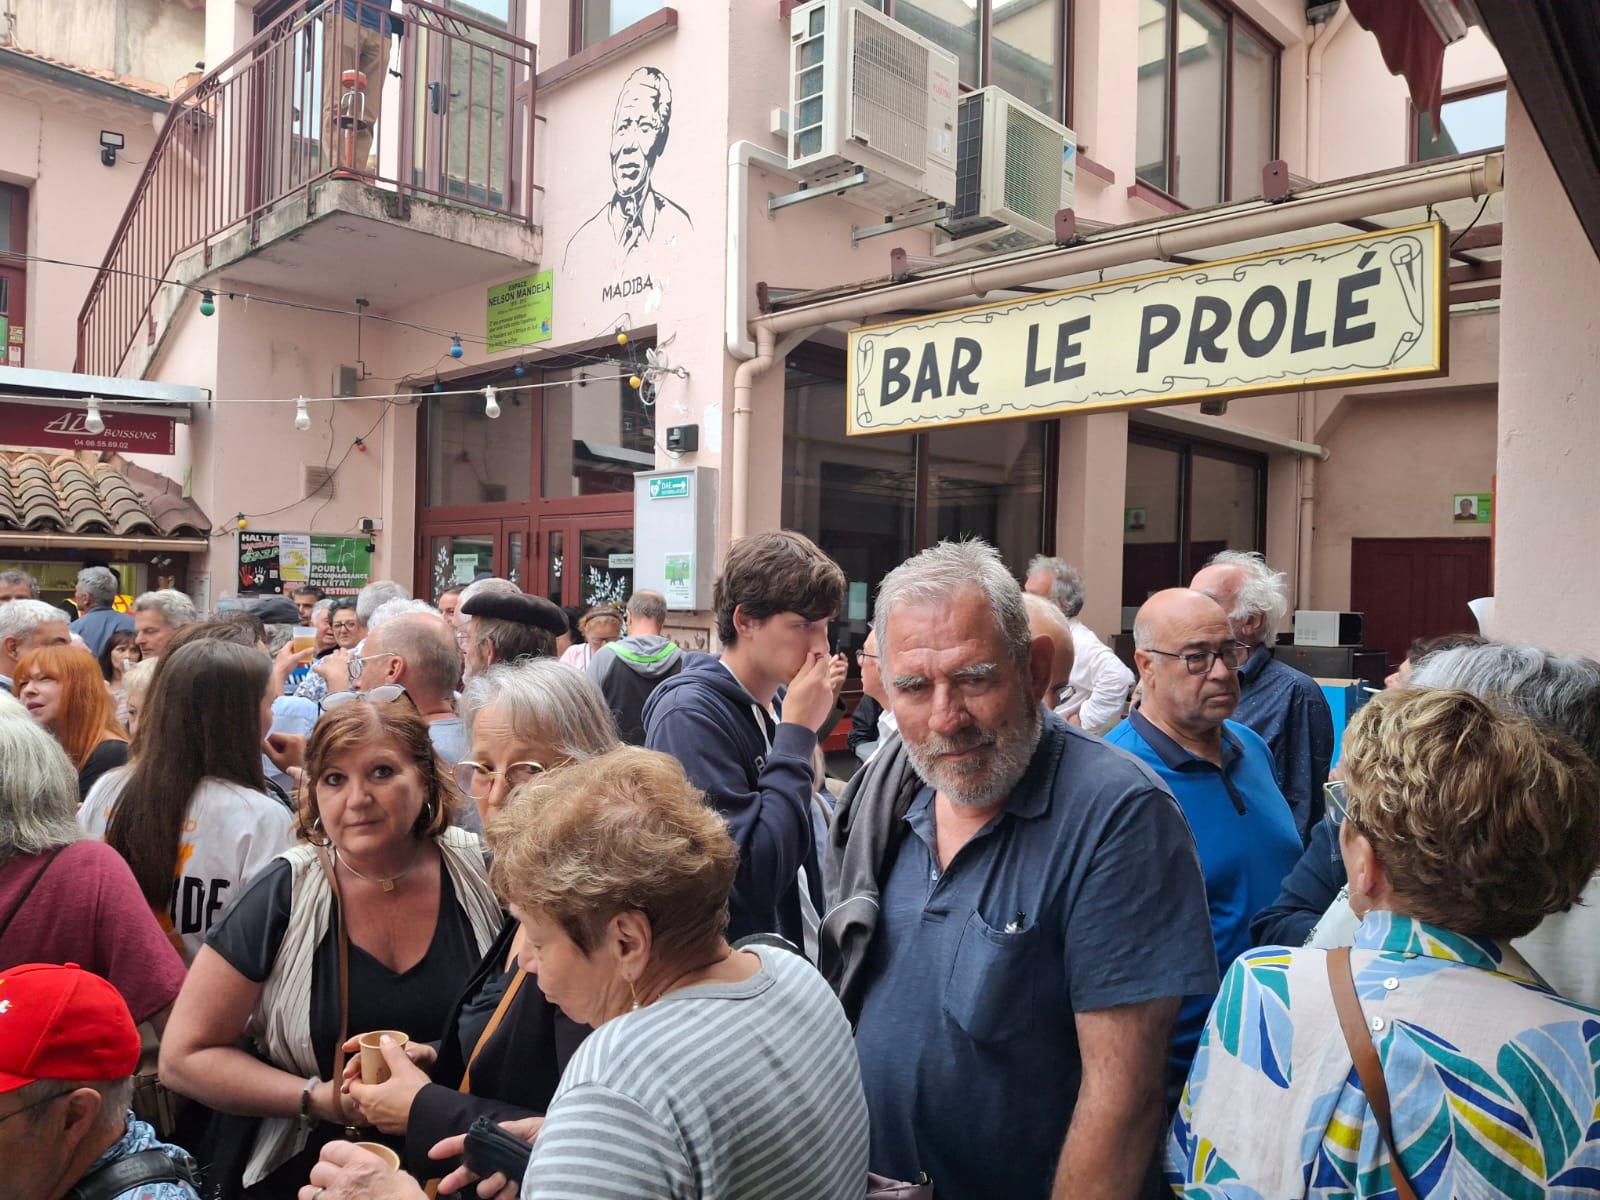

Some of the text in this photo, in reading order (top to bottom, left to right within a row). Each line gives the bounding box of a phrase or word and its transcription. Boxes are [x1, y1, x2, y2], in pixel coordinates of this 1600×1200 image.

[488, 292, 515, 307] NELSON
[517, 281, 551, 299] MANDELA
[602, 274, 653, 303] MADIBA
[879, 251, 1382, 408] BAR LE PROLÉ
[103, 428, 158, 440] BOISSONS
[241, 534, 272, 542] HALTE
[311, 565, 347, 573] POUR LA
[310, 579, 321, 587] DE
